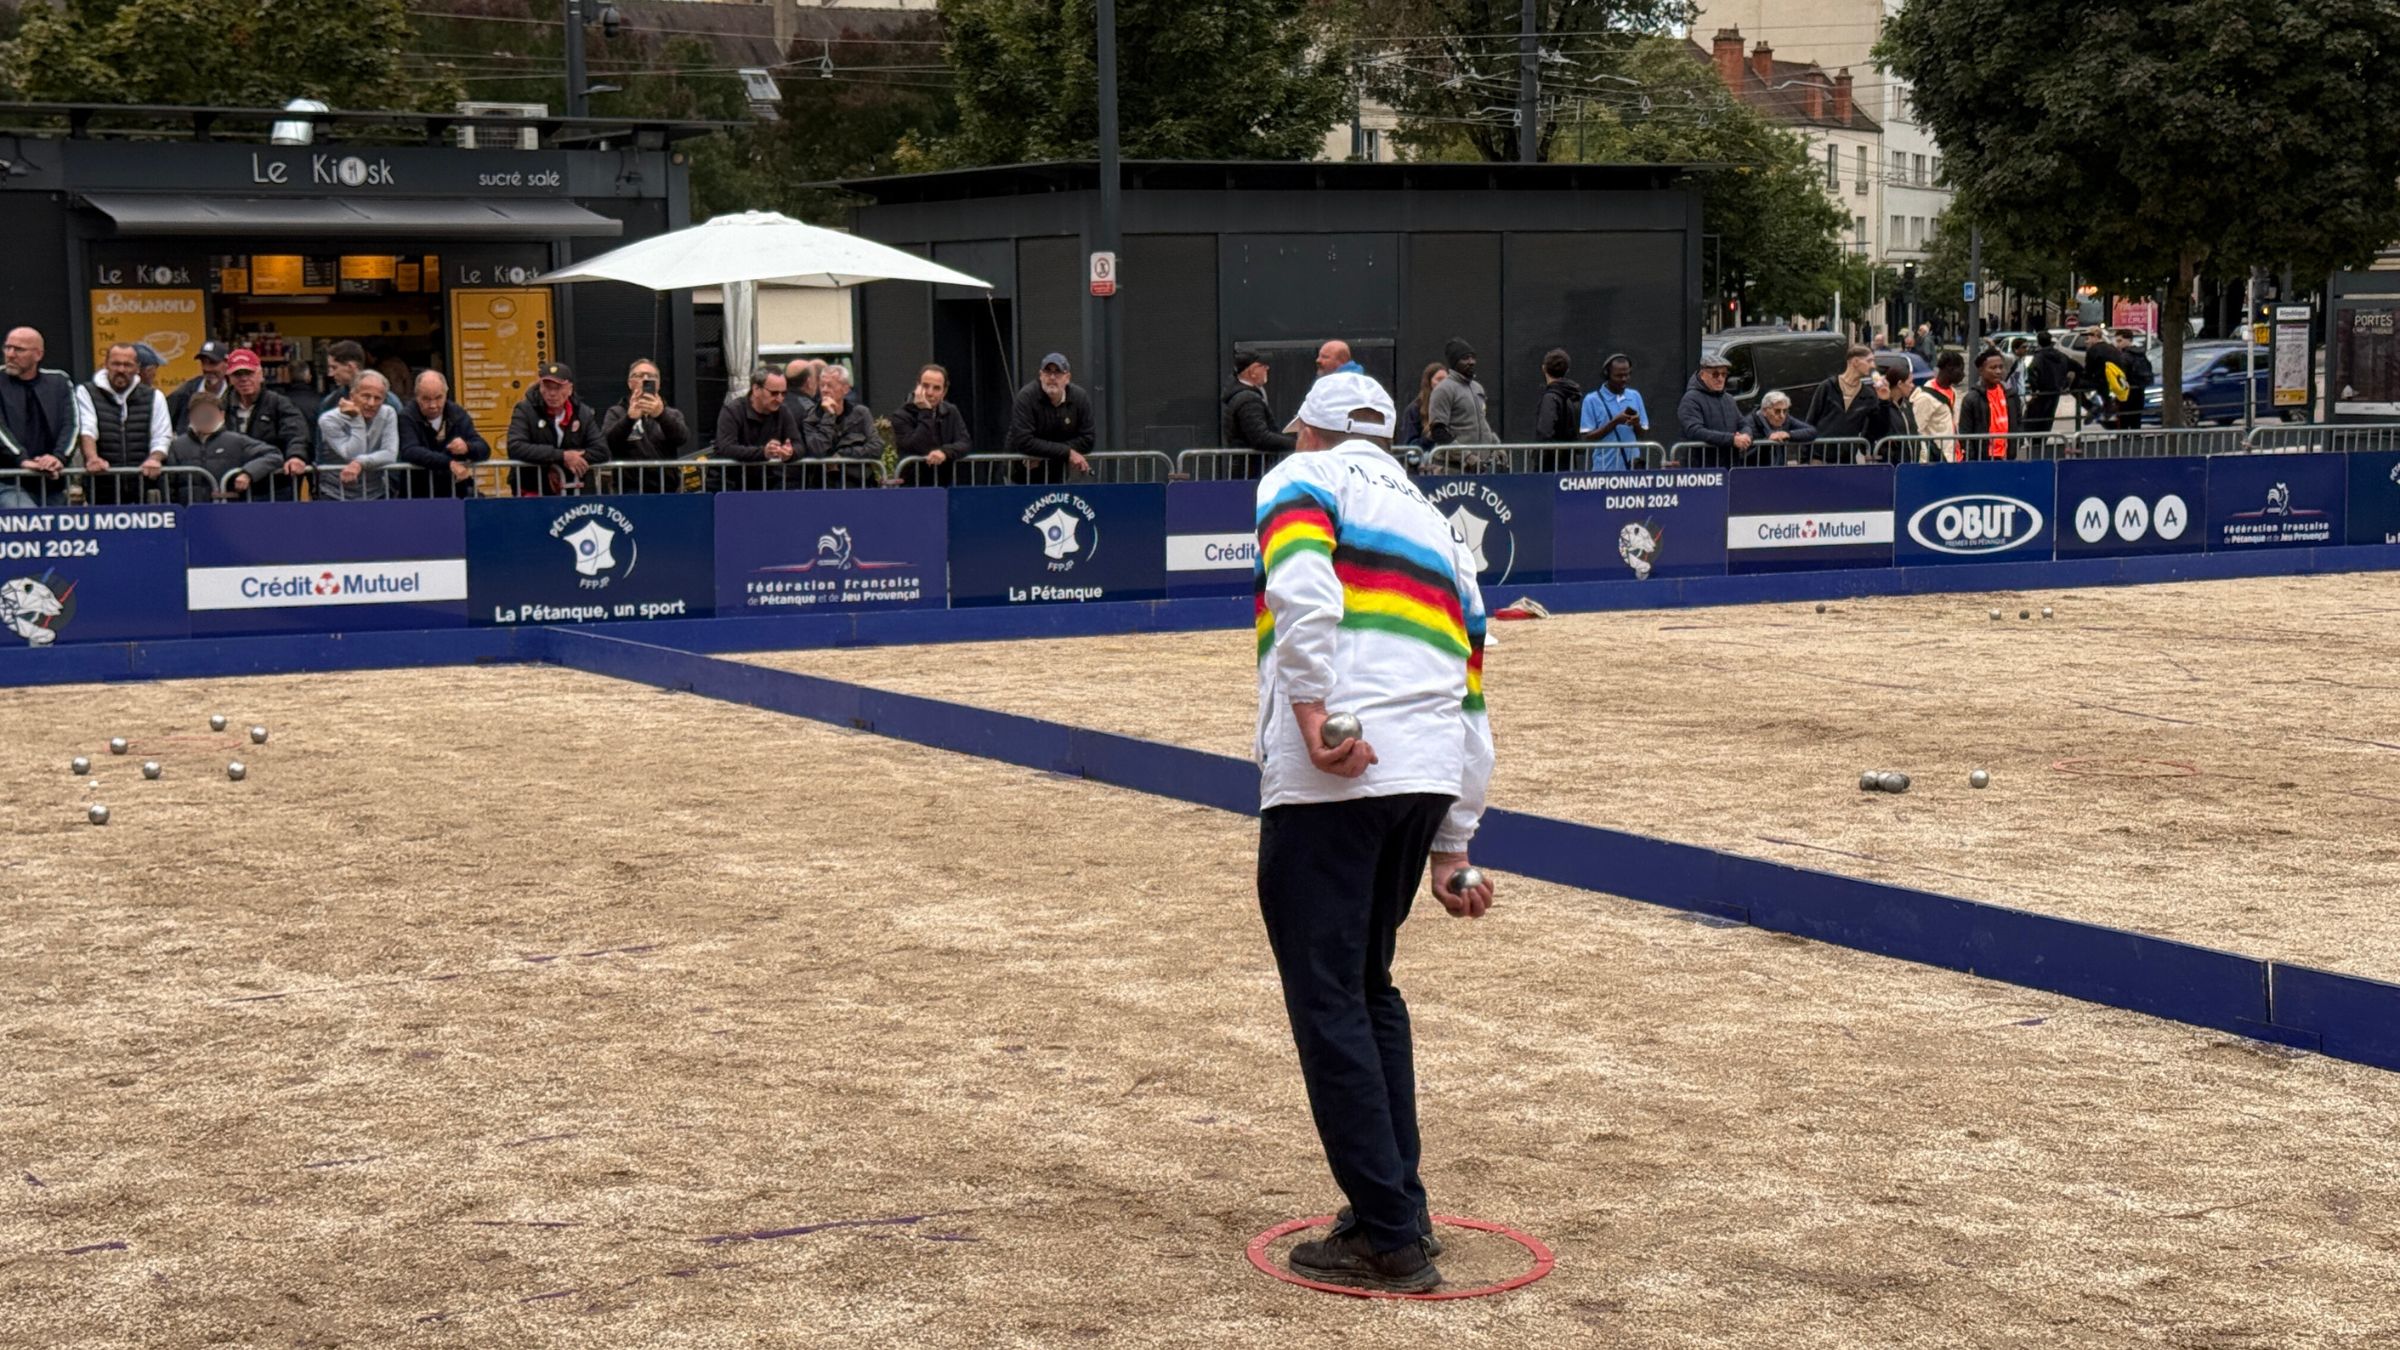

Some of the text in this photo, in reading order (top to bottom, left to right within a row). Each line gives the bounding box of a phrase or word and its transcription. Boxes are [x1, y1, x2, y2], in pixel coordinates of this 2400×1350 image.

[252, 152, 288, 183] Le
[479, 169, 560, 186] sucré salé
[98, 265, 123, 284] Le
[460, 265, 481, 284] Le
[2354, 314, 2394, 327] PORTES
[1559, 473, 1723, 491] CHAMPIONNAT DU MONDE
[1022, 493, 1096, 524] PÉTANQUE TOUR
[1480, 486, 1512, 524] TOUR
[1606, 494, 1679, 509] DIJON 2024
[58, 513, 90, 531] DU
[94, 512, 176, 530] MONDE
[549, 503, 634, 538] PÉTANQUE TOUR
[1758, 520, 1866, 540] Crédit Mutuel
[1936, 505, 2016, 540] OBUT
[45, 539, 99, 557] 2024
[1205, 543, 1256, 561] Crédit
[241, 572, 420, 598] Crédit Mutuel
[747, 576, 920, 593] Fédération Française
[1009, 585, 1103, 603] La Pétanque
[747, 589, 920, 607] de Pétanque et de Jeu Provençal
[495, 599, 685, 623] La Pétanque, un sport
